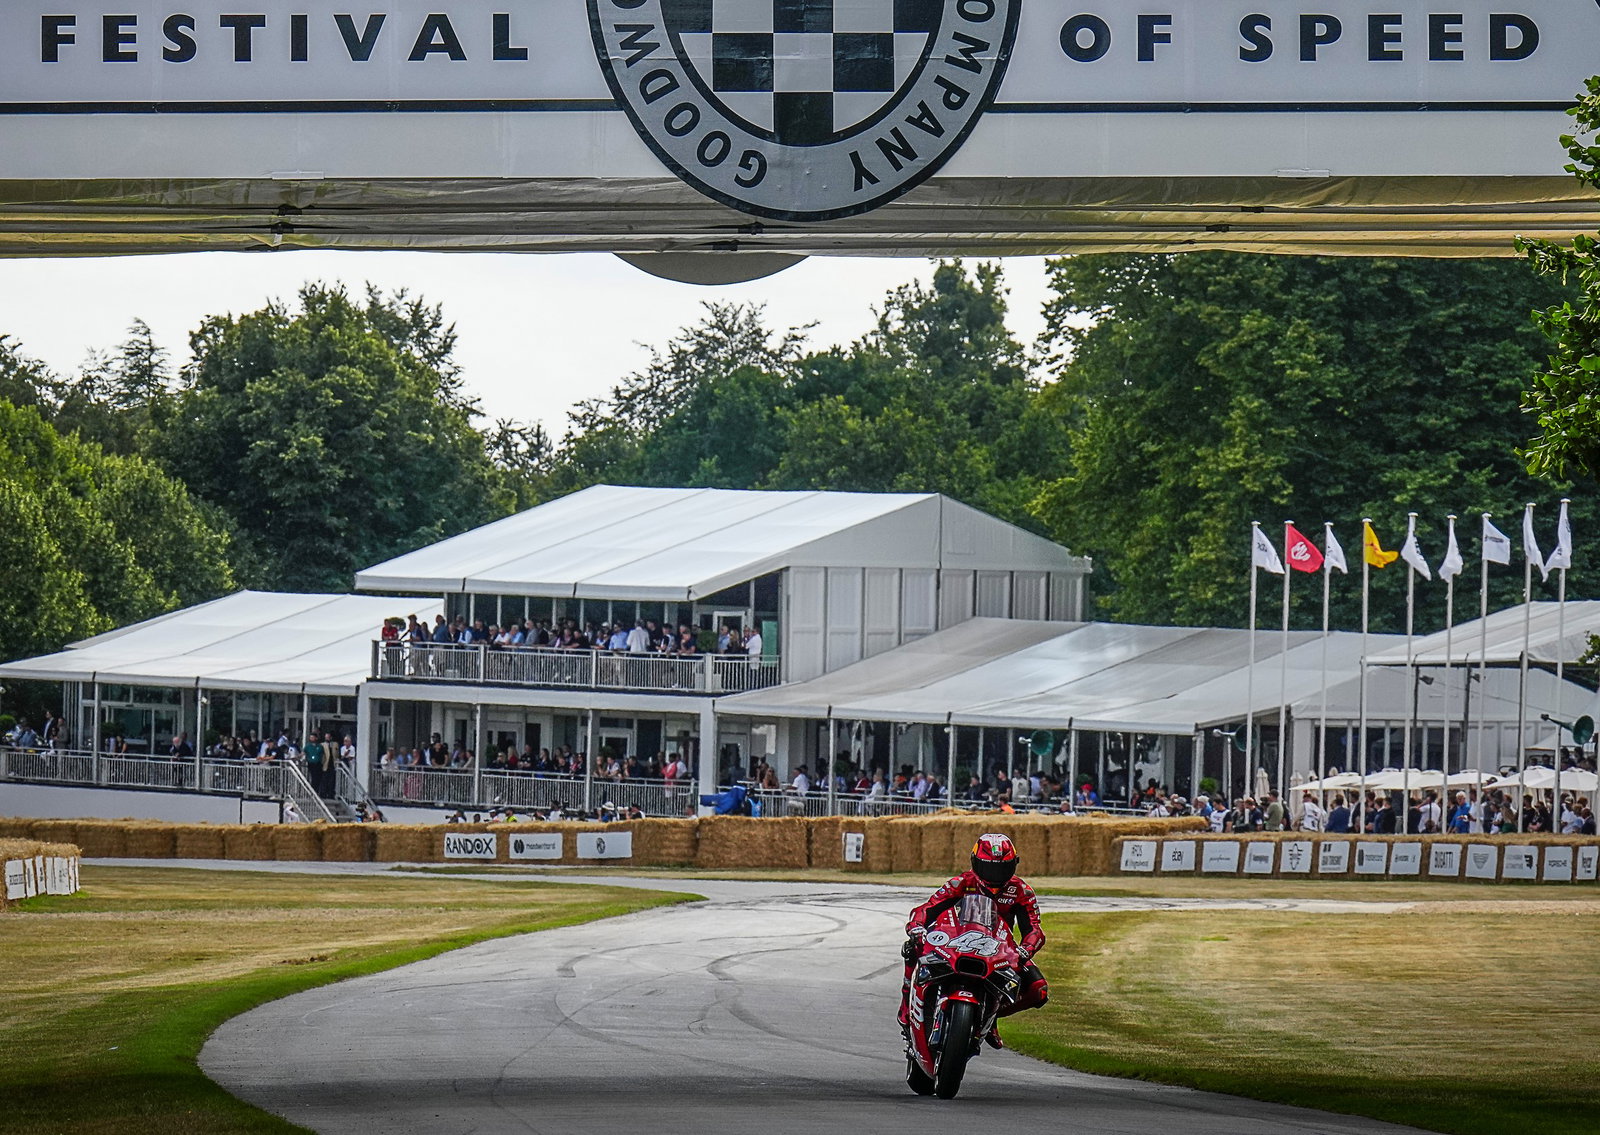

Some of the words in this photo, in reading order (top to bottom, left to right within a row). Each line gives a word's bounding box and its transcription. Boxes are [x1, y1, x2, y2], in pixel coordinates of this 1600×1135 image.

[39, 13, 530, 63] FESTIVAL
[1058, 13, 1172, 63] OF
[1238, 13, 1541, 63] SPEED
[611, 0, 769, 188] GOODW
[848, 0, 996, 191] OMPANY
[446, 837, 493, 854] RANDOX
[1172, 848, 1183, 864] ebay
[946, 930, 1001, 957] 44
